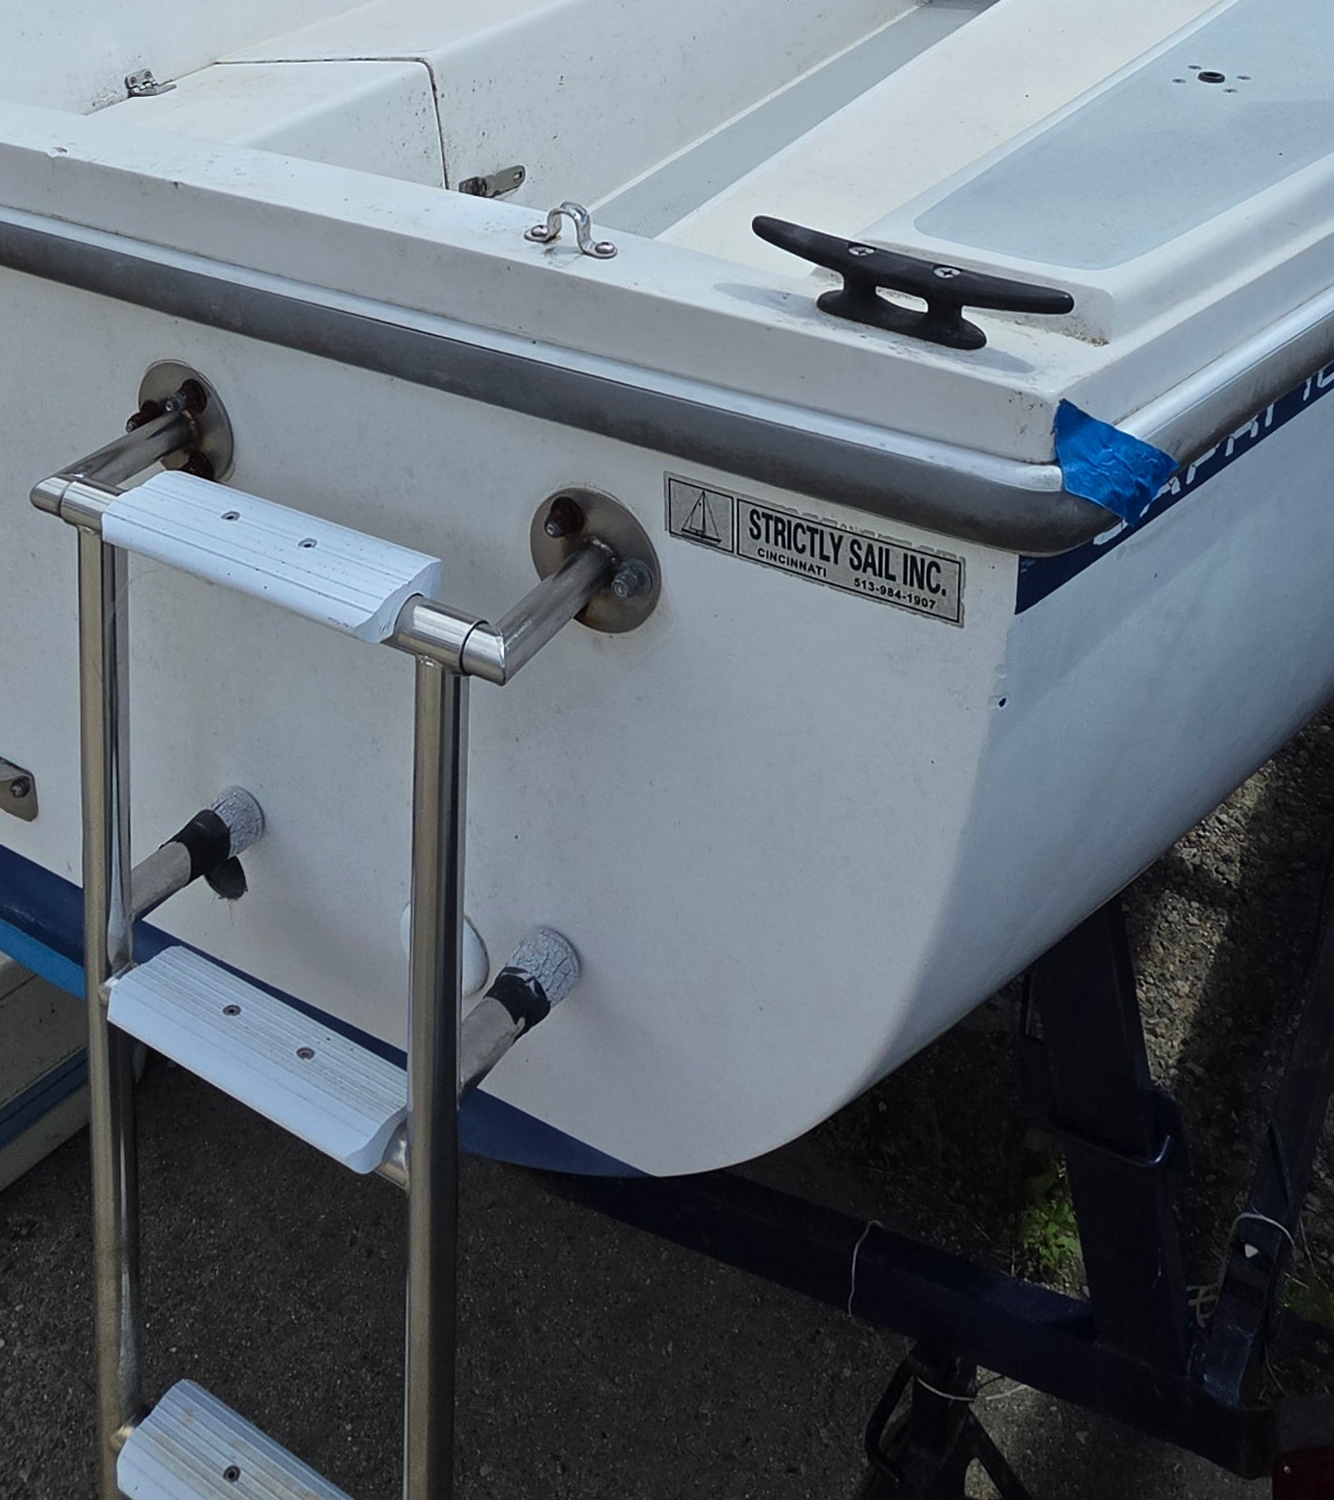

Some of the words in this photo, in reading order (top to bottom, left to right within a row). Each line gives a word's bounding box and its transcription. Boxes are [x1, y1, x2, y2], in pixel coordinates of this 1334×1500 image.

[748, 508, 844, 565] STRICTLY
[849, 538, 897, 582] SAIL
[902, 552, 947, 597] INC.
[757, 547, 827, 578] CINCINNATI
[853, 577, 937, 610] 513-984-1907
